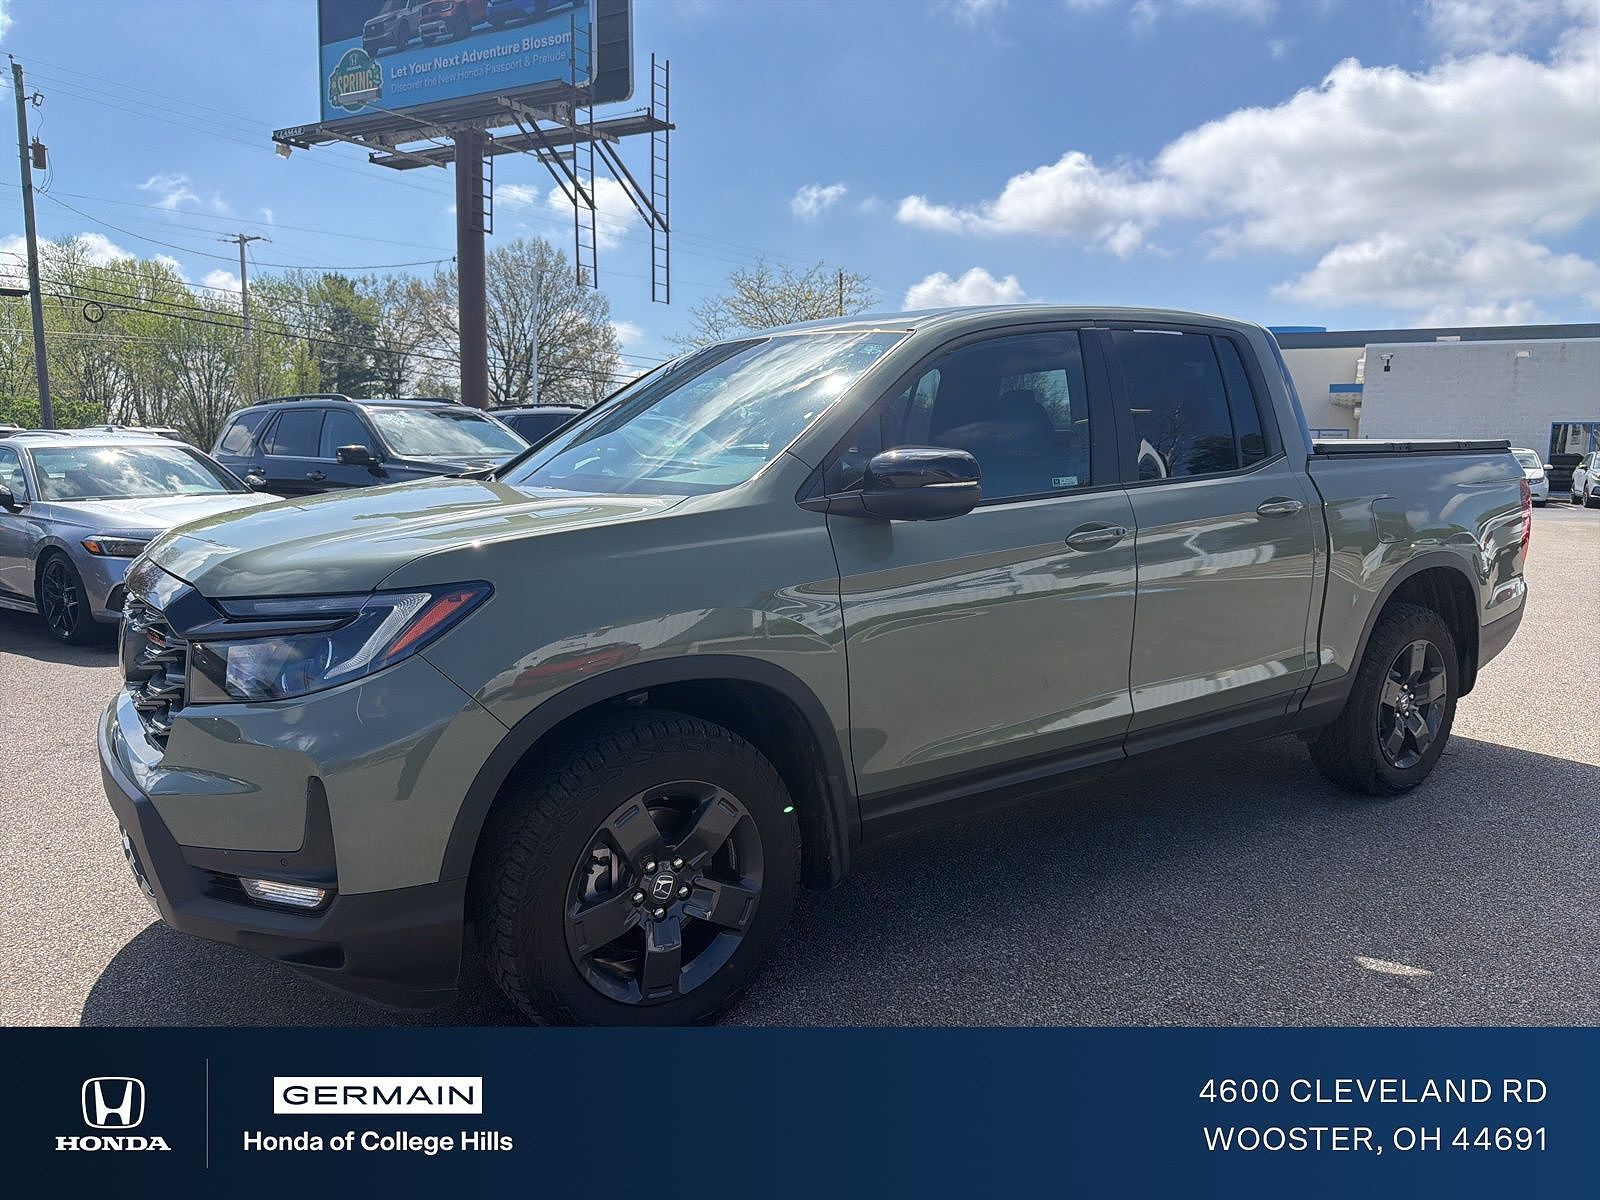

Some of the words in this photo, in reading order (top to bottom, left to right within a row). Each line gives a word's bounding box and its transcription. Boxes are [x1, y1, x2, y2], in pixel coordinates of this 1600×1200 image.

[391, 66, 408, 79] Let
[409, 62, 432, 75] Your
[434, 54, 460, 70] Next
[461, 43, 520, 64] Adventure
[522, 32, 572, 51] Blossom
[391, 80, 423, 94] Discover
[458, 67, 484, 79] Honda
[486, 58, 522, 74] Passport
[523, 55, 532, 68] &
[533, 49, 566, 64] Prelude
[337, 70, 373, 95] SPRING
